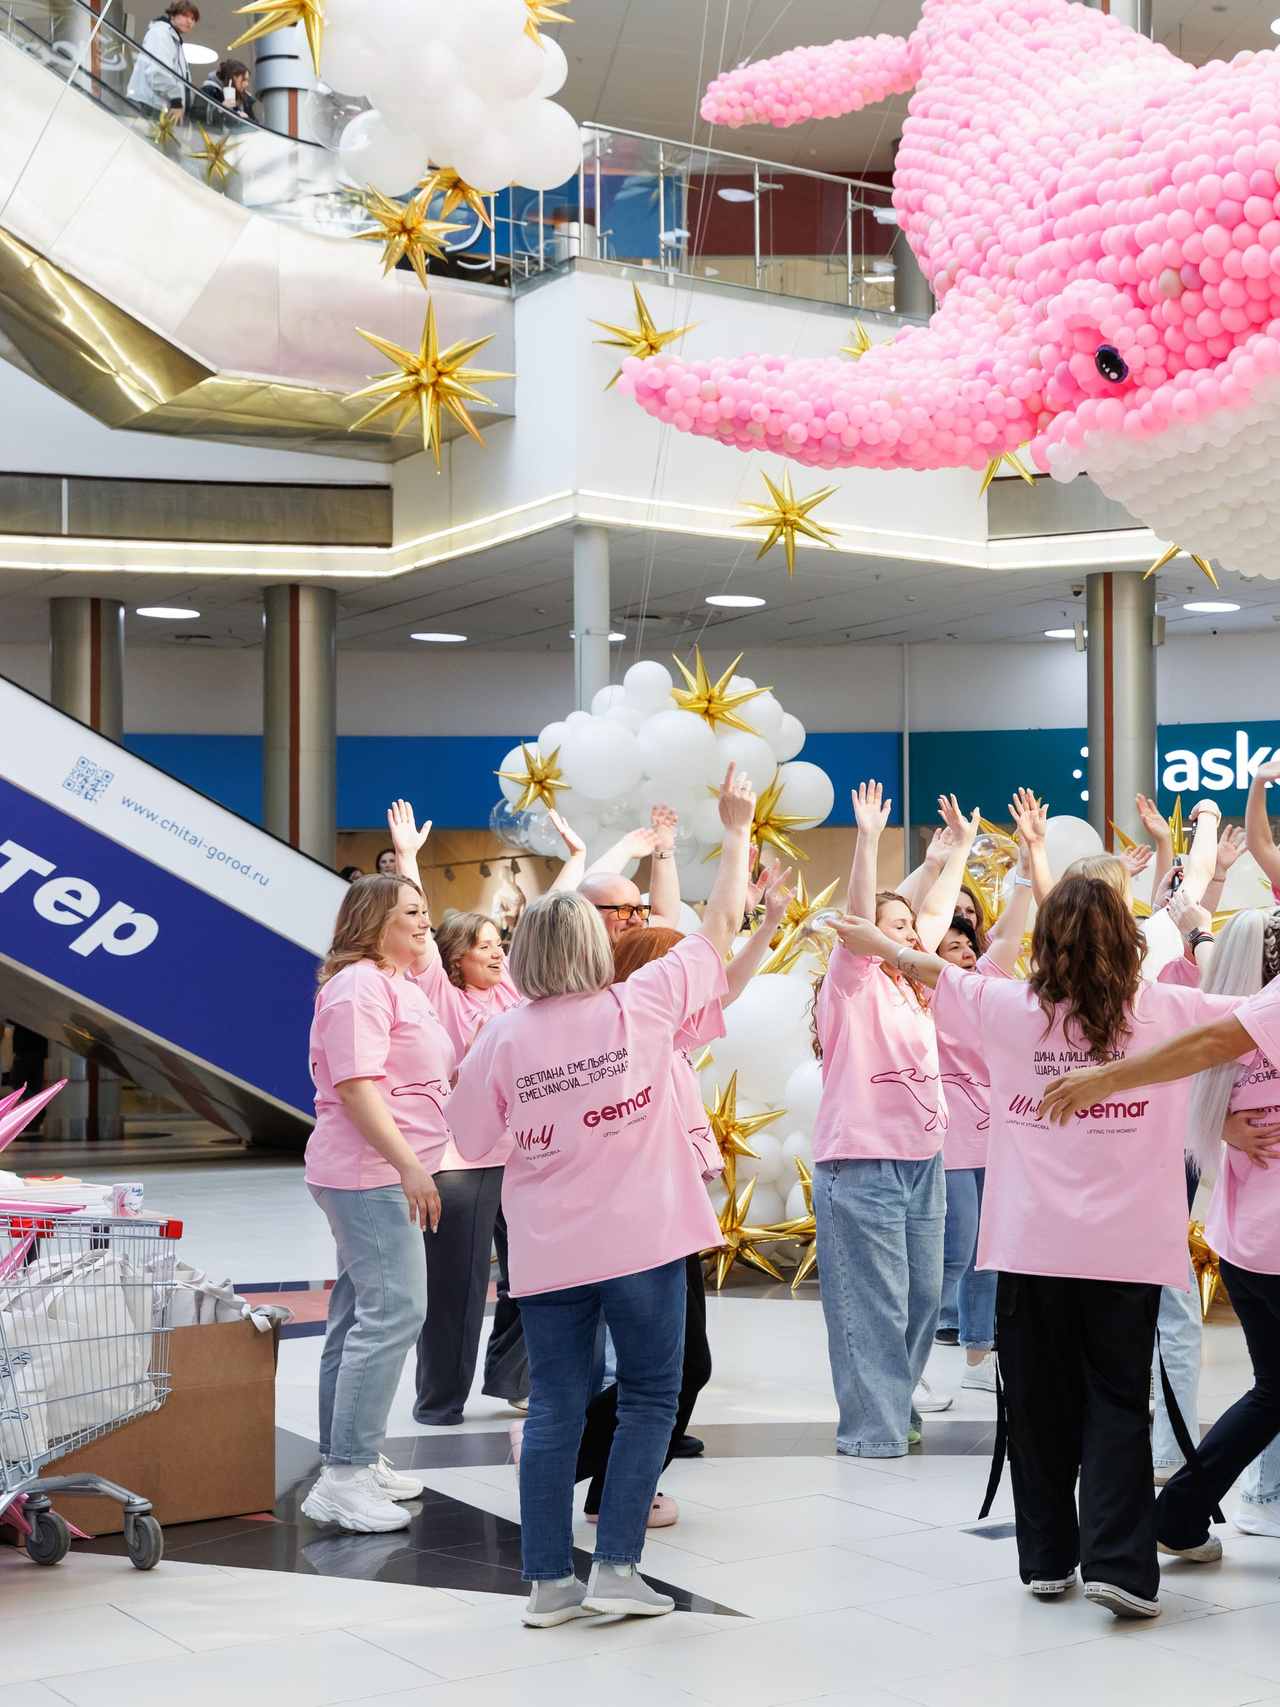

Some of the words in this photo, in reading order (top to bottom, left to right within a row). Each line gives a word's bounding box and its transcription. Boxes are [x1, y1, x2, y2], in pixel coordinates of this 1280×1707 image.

[121, 795, 270, 887] www.chitai-gorod.ru
[516, 1066, 566, 1089] СВЕТЛАНА
[567, 1047, 629, 1075] ЕМЕЛЬЯНОВА
[1034, 1051, 1056, 1063] ДИНА
[1034, 1064, 1060, 1076] ШАРЫ
[582, 1086, 652, 1128] Gemar
